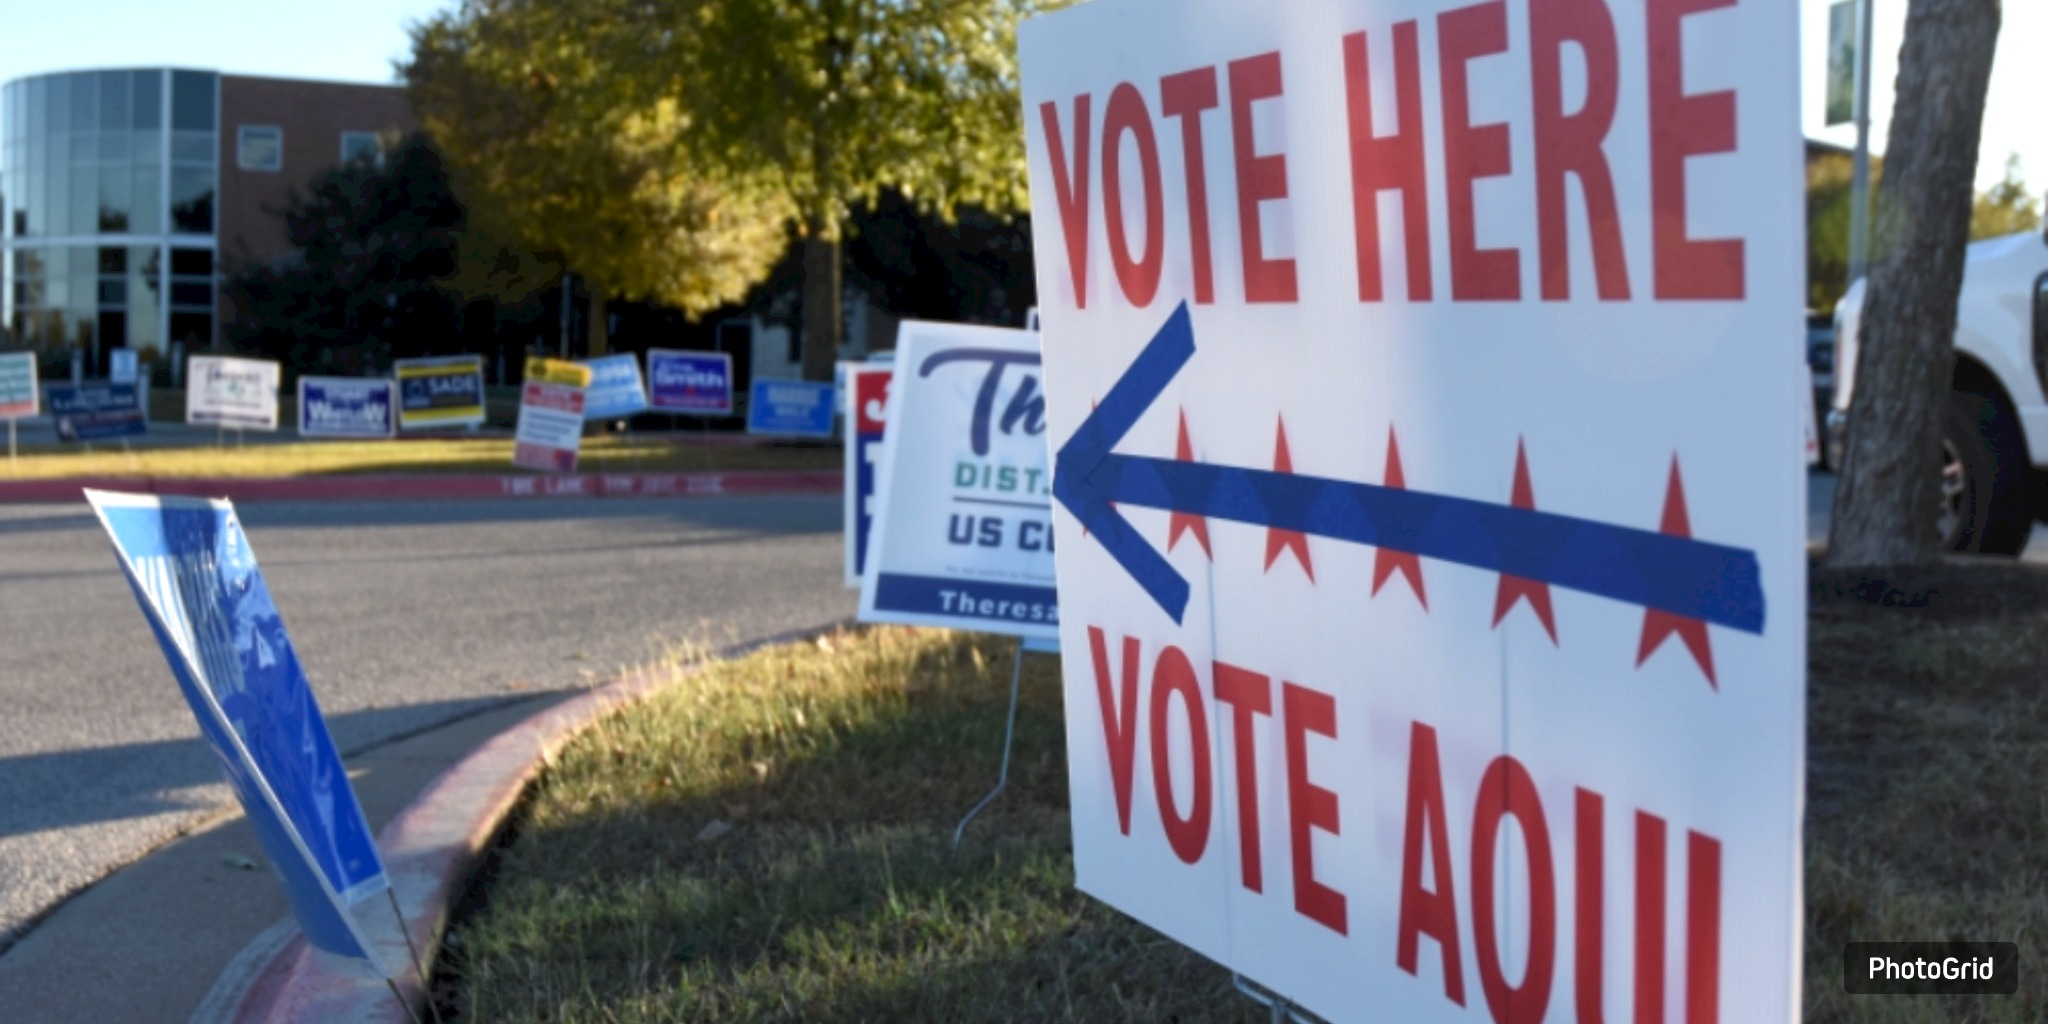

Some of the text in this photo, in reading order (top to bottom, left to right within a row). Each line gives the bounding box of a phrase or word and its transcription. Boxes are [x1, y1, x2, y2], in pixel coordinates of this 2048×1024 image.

[1039, 0, 1746, 310] VOTE HERE
[940, 589, 1058, 621] Theresa
[947, 513, 1004, 549] US
[1087, 624, 1349, 938] VOTE
